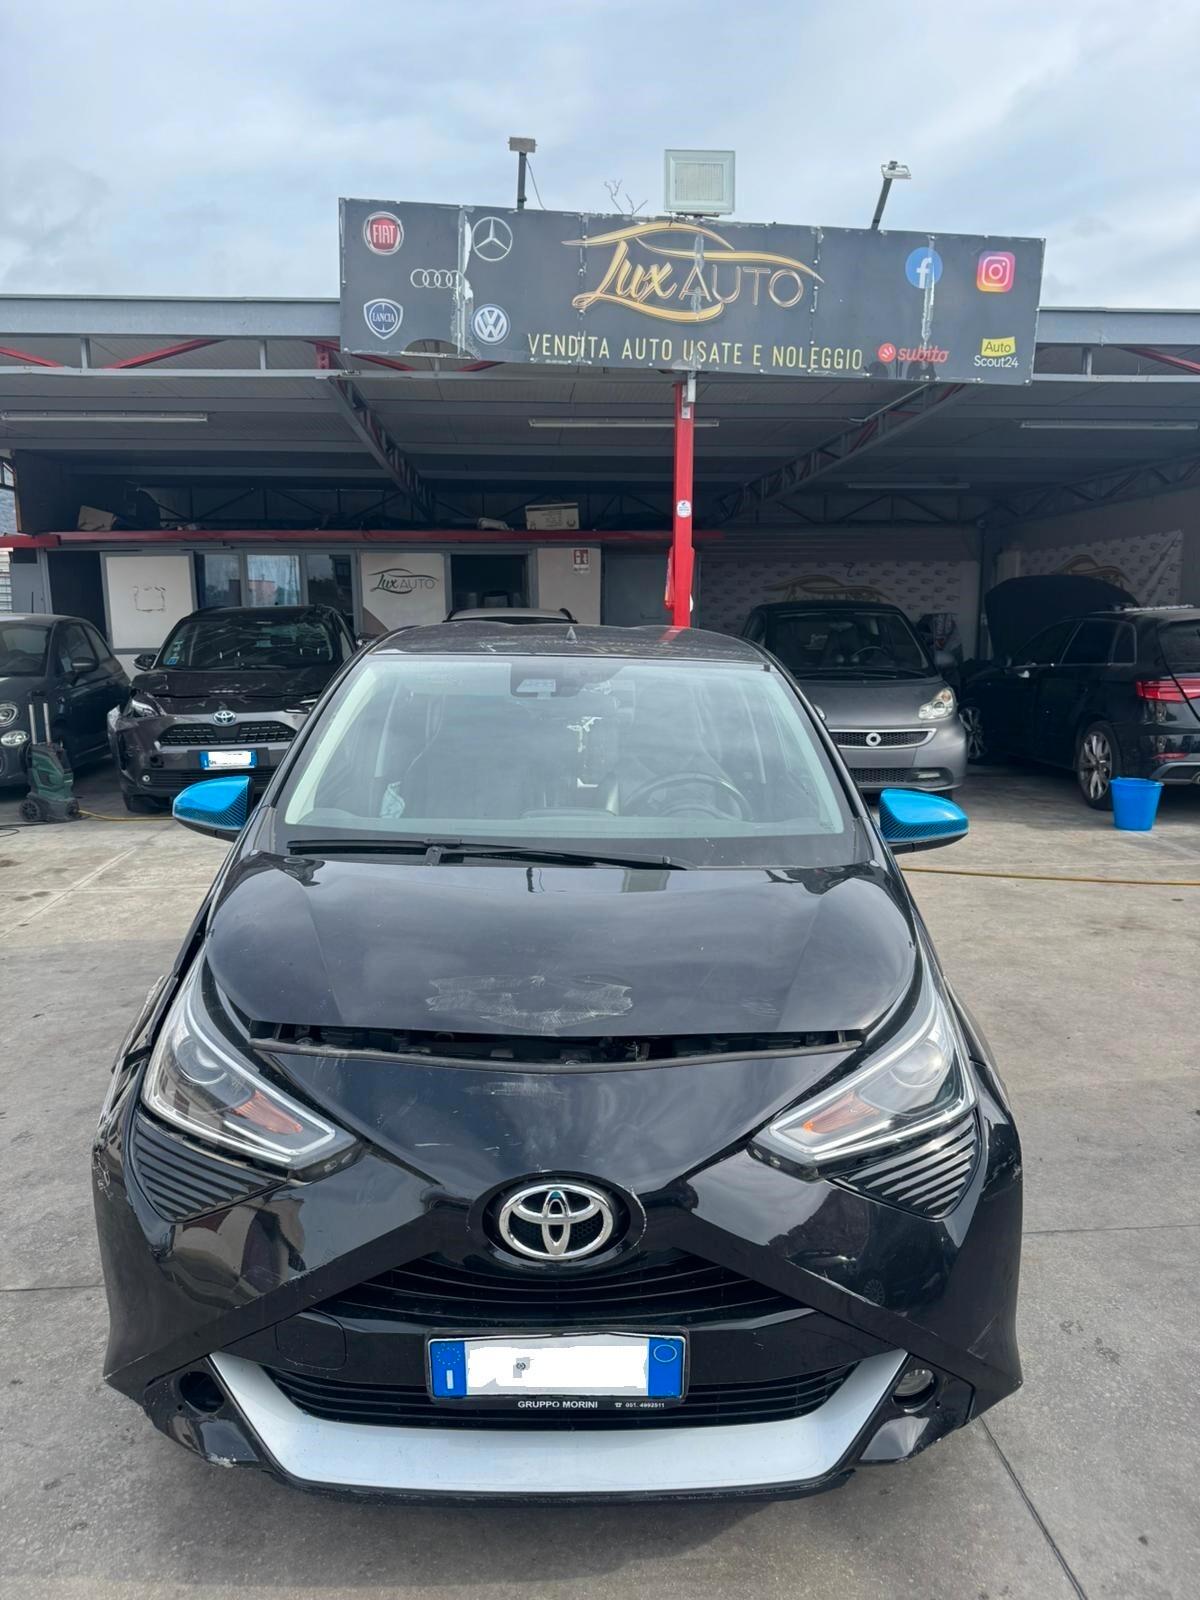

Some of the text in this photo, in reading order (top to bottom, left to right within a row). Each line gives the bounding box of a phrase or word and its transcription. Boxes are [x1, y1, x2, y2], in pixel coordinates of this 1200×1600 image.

[372, 224, 395, 244] FIAT
[572, 240, 804, 312] Lux AUTO
[372, 312, 394, 322] LANCIA
[527, 333, 864, 372] VENDITA AUTO USATE E NOLEGGIO
[898, 345, 949, 363] subito
[983, 341, 1012, 353] Auto
[974, 354, 1019, 368] Scout24
[371, 574, 436, 592] Lux AUTO
[517, 1400, 560, 1409] GRUPPO
[562, 1400, 598, 1409] MORINI
